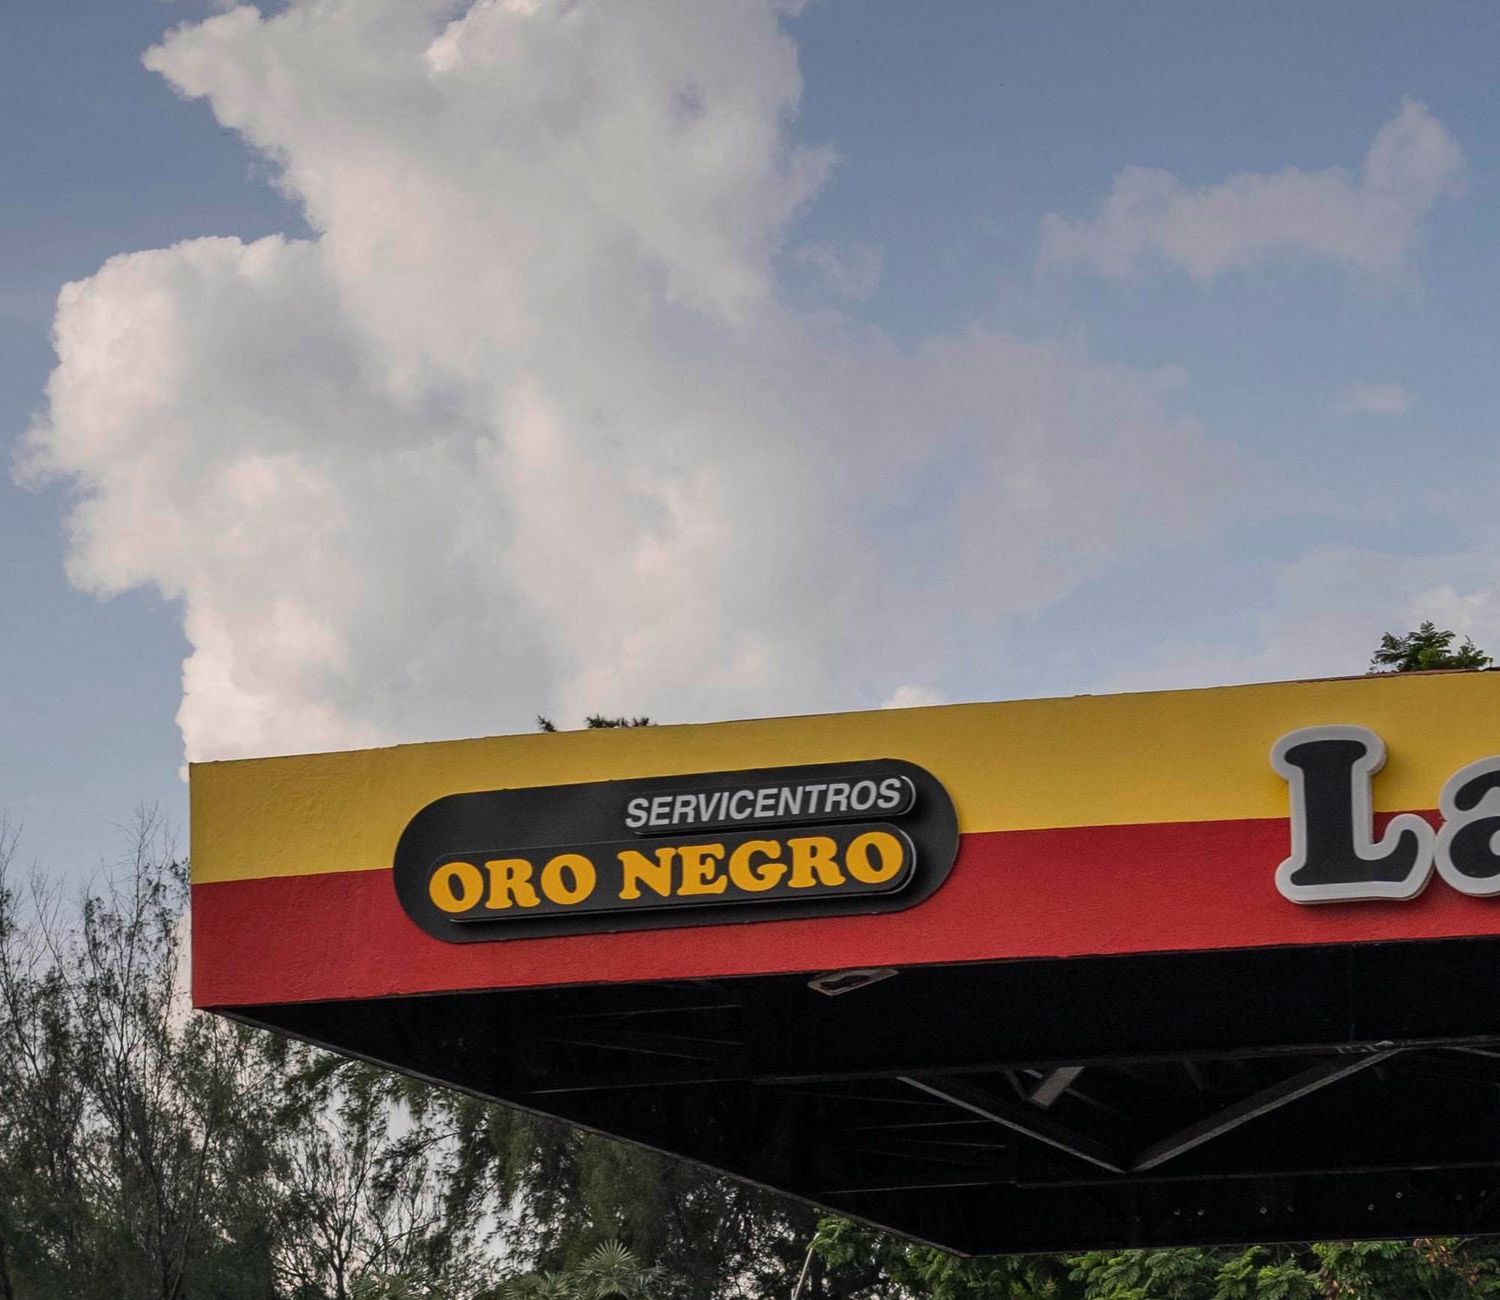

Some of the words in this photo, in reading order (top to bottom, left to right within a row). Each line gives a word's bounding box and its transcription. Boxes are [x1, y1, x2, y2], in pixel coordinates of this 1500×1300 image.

[624, 776, 905, 829] SERVICENTROS
[429, 853, 597, 914] ORO
[617, 830, 904, 901] NEGRO
